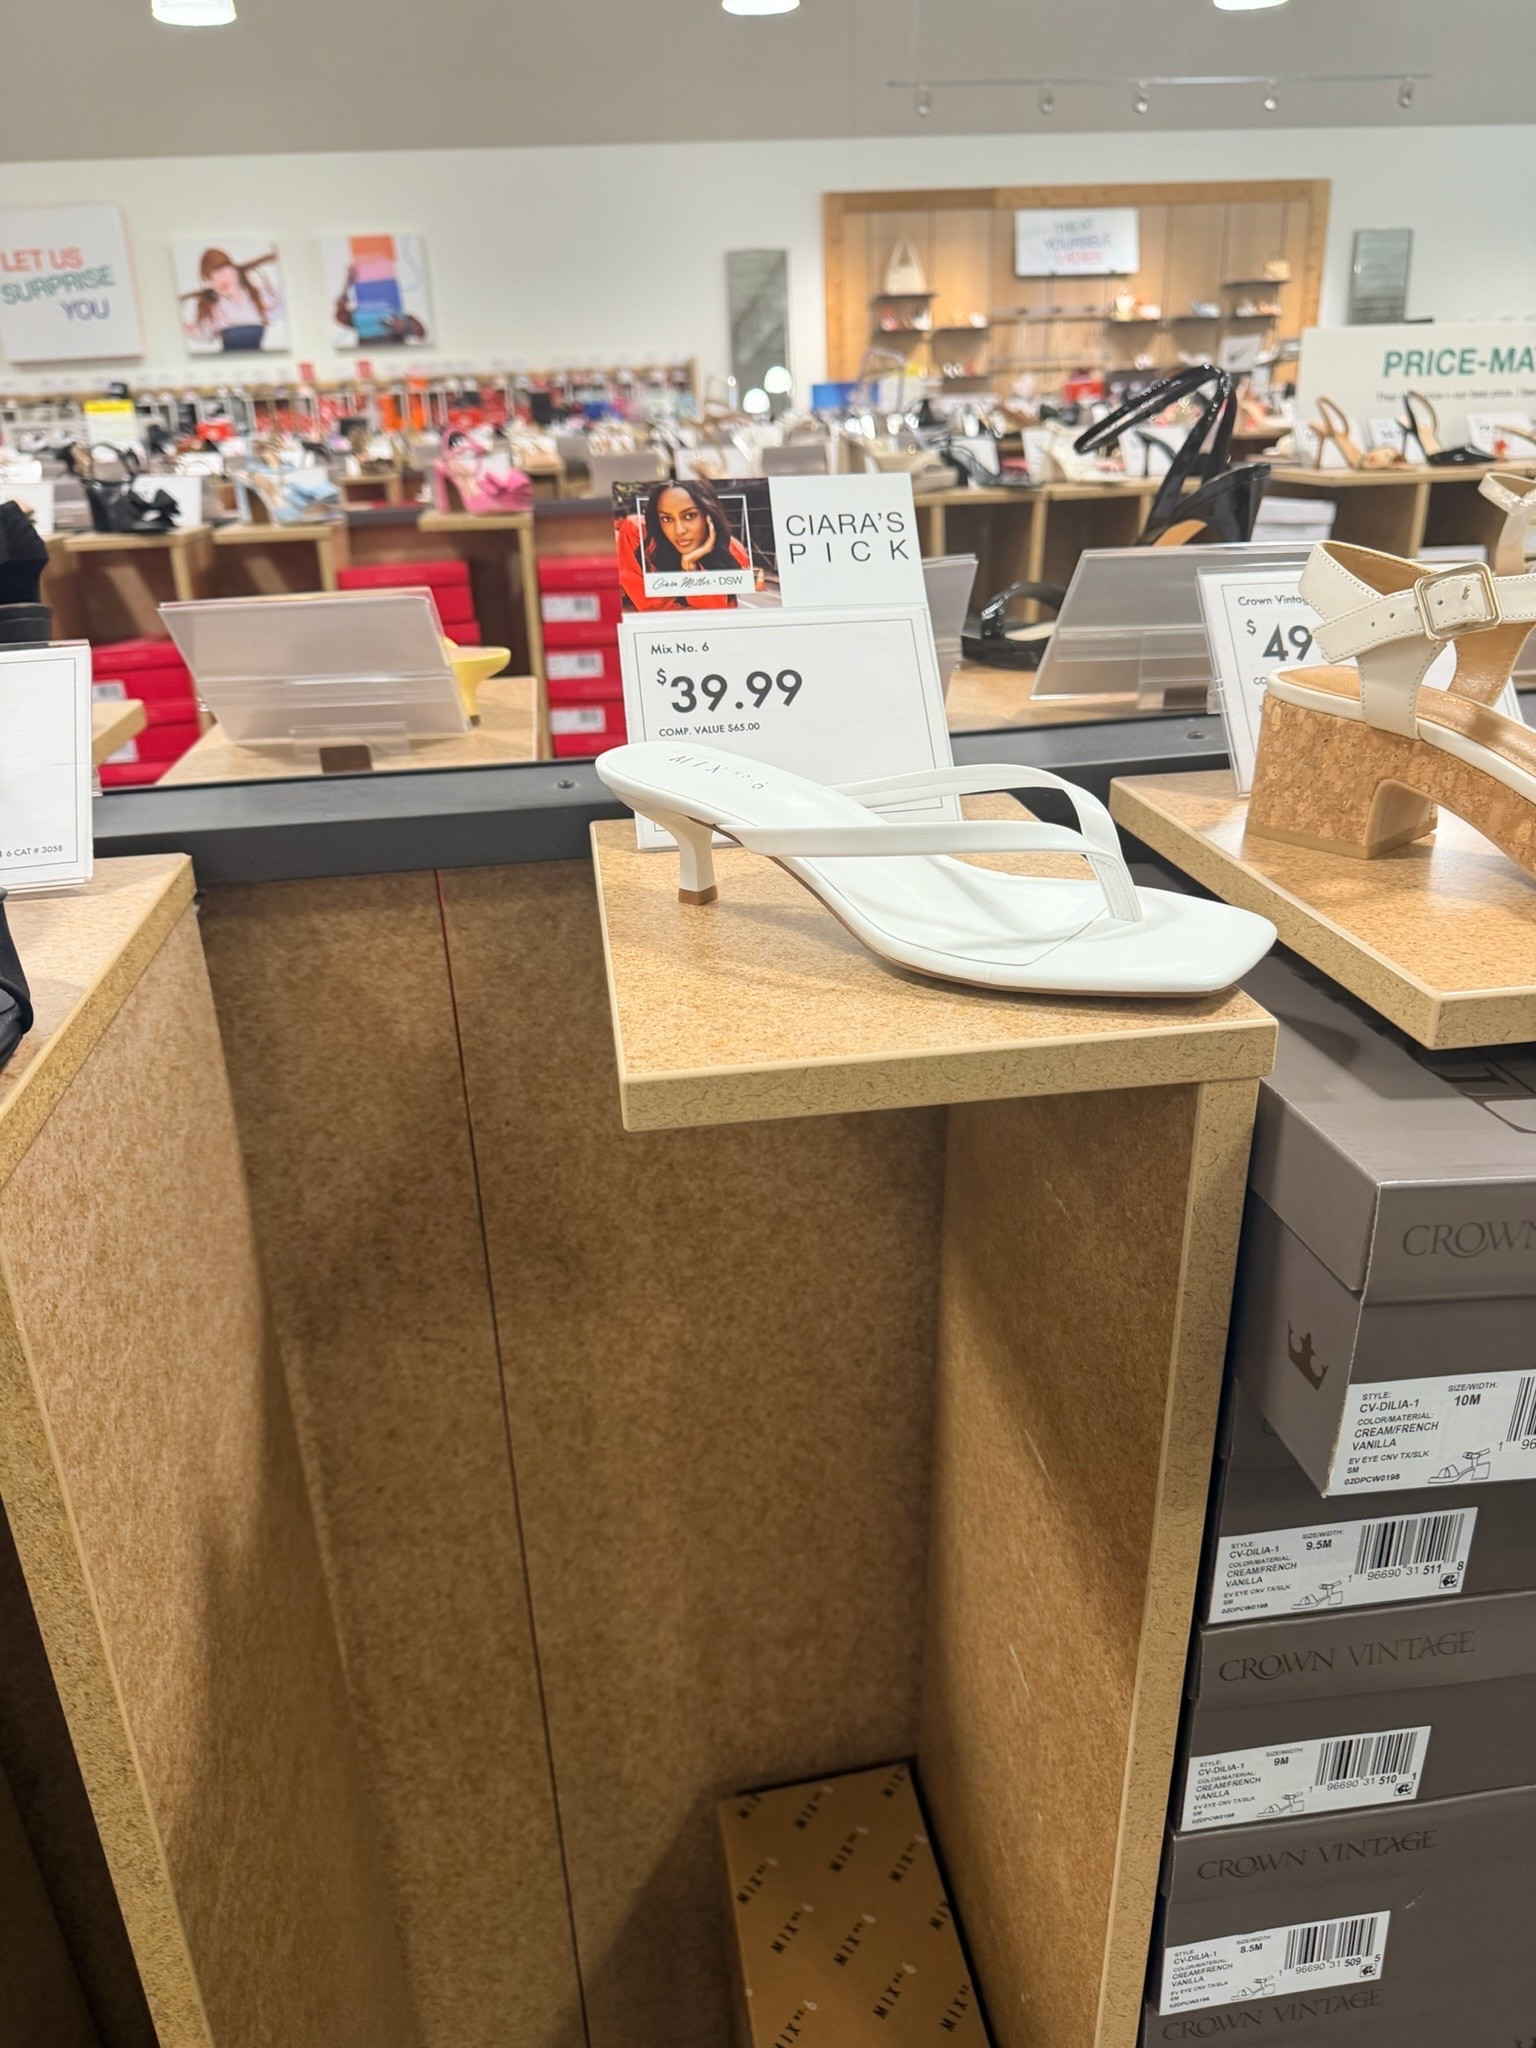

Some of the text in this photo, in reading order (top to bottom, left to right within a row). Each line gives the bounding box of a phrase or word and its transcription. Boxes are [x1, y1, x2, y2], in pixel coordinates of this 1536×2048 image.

[0, 245, 85, 272] LET US
[0, 263, 117, 305] SURPRISE
[59, 296, 110, 321] YOU
[1382, 346, 1536, 378] PRICE-MA
[786, 512, 906, 536] CIARA'S
[789, 539, 910, 564] PICK
[718, 576, 743, 586] DSW
[1238, 596, 1273, 606] Crown
[651, 642, 709, 655] Mix No. 6
[657, 667, 803, 713] $39.99
[659, 722, 760, 737] COMP. VALUE $65.00
[14, 847, 31, 856] CAT
[41, 844, 64, 854] 3058
[1362, 1392, 1391, 1400] STYLE:
[1454, 1394, 1481, 1406] 10M
[1360, 1399, 1419, 1413] CV-DILIA-1
[1354, 1421, 1439, 1438] CREAM/FRENCH
[1352, 1438, 1397, 1451] VANILLA
[1349, 1457, 1360, 1465] EV
[1362, 1455, 1379, 1464] EYE
[1380, 1453, 1399, 1462] CNV
[1229, 1545, 1279, 1559] CV-DILIA-1
[1305, 1539, 1332, 1551] 9.5M
[1227, 1562, 1297, 1578] CREAM/FRENCH
[1367, 1568, 1401, 1581] 96690
[1406, 1566, 1419, 1576] 31
[1423, 1563, 1442, 1575] 511
[1225, 1576, 1263, 1588] VANILLA
[1218, 1630, 1476, 1682] CROWN VINTAGE
[1273, 1756, 1289, 1766] 9M
[1197, 1763, 1244, 1776] CV-DILIA-1
[1195, 1776, 1261, 1793] CREAM/FRENCH
[1326, 1779, 1359, 1791] 96690
[1363, 1777, 1375, 1786] 31
[1379, 1774, 1397, 1785] 510
[1412, 1772, 1417, 1780] 1
[1194, 1790, 1230, 1801] VANILLA
[1196, 1829, 1438, 1880] CROWN VINTAGE
[770, 1923, 798, 1954] MIX
[833, 1934, 860, 1967] MIX
[1240, 1943, 1263, 1954] 8.5M
[1173, 1951, 1217, 1965] CV-DILIA-1
[1295, 1963, 1326, 1975] 96690
[1329, 1960, 1341, 1969] 31
[1344, 1957, 1362, 1967] 509
[1374, 1954, 1381, 1962] 5
[1171, 1975, 1204, 1988] VANILLA
[873, 1985, 902, 2020] MIX
[940, 1998, 968, 2033] MIX
[1162, 1988, 1384, 2042] CROWN VINTAGE
